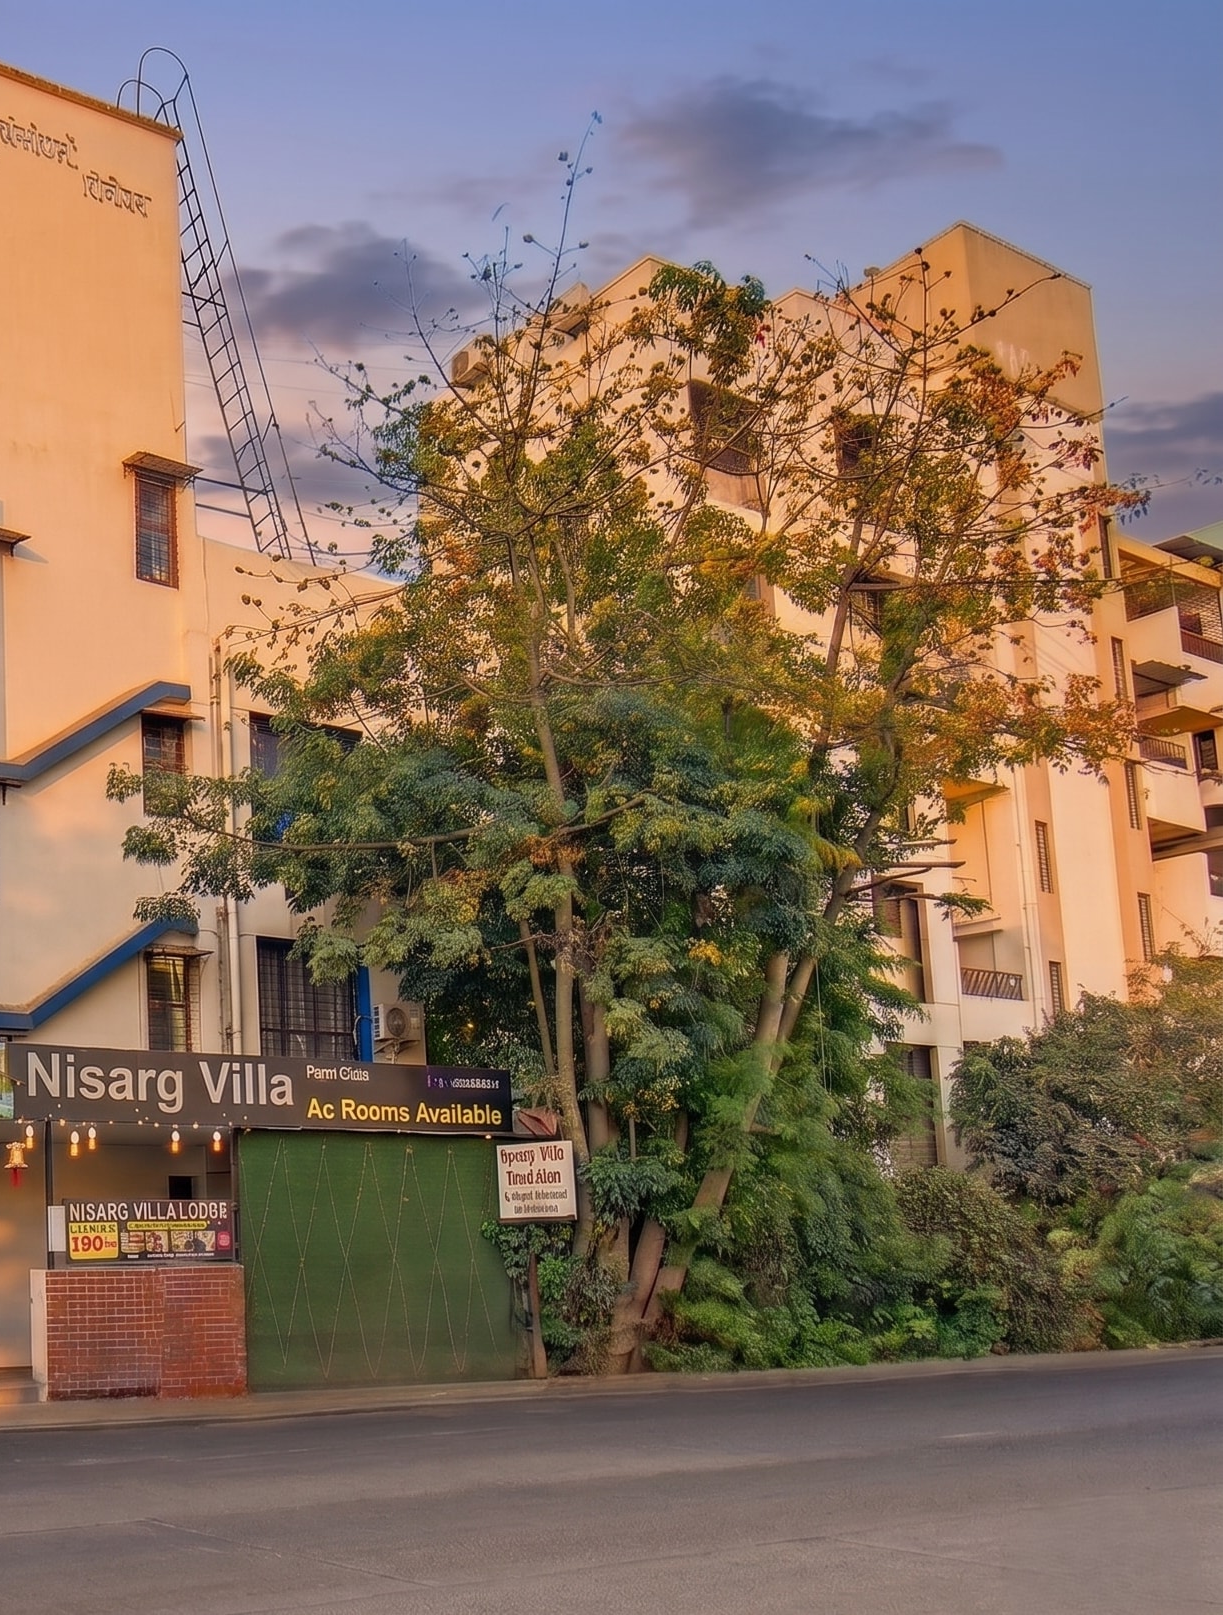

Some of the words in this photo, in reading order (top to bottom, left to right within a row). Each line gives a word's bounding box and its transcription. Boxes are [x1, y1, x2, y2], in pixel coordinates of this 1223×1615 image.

[27, 1052, 184, 1113] Nisarg
[199, 1060, 294, 1106] Villa
[307, 1098, 335, 1119] Ac
[341, 1099, 410, 1122] Rooms
[415, 1102, 503, 1125] Available
[69, 1203, 128, 1221] NISARG
[134, 1202, 177, 1220] VILLA
